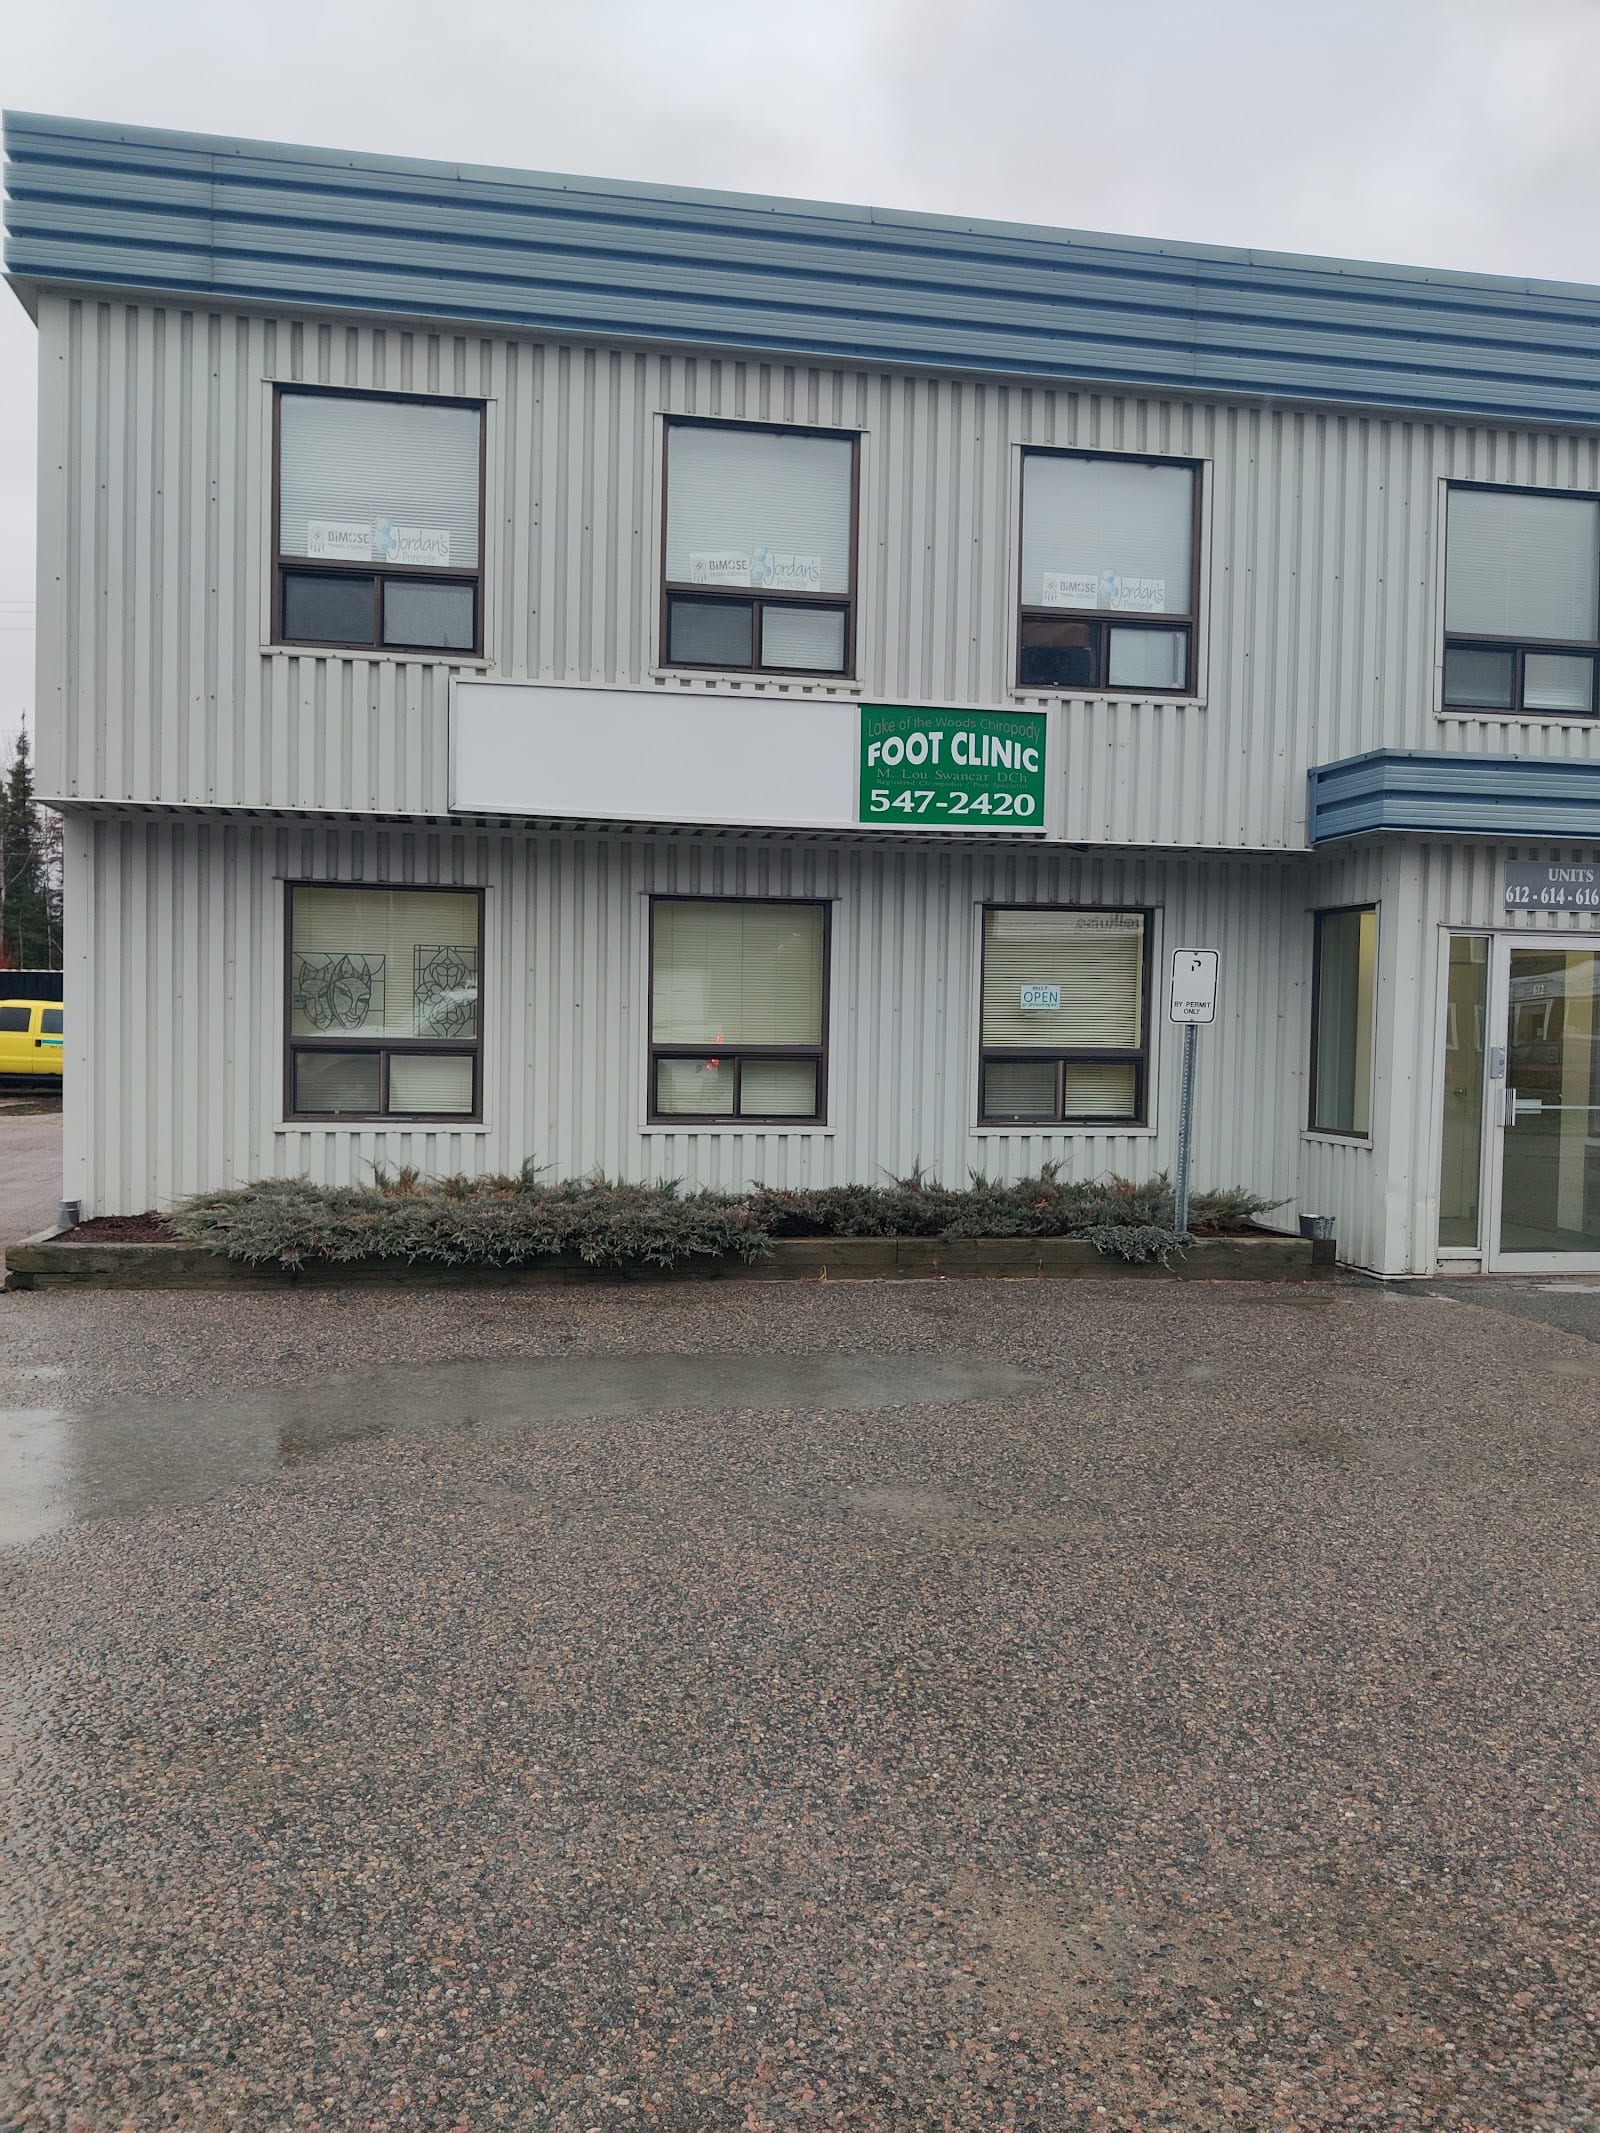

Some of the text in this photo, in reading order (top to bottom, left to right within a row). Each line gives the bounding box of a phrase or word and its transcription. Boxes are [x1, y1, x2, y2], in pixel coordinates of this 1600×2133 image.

[387, 528, 449, 561] Jordan's
[763, 554, 819, 586] Jordan's
[1110, 577, 1164, 608] Jordan's
[868, 717, 1040, 745] Lake of the Woods Chiropody
[868, 731, 1039, 773] FOOT CLINIC
[876, 768, 1028, 783] M. Lou Swancar DCh
[870, 789, 1036, 817] 547-2420
[1548, 868, 1594, 882] UNITS
[1024, 991, 1058, 1003] OPEN
[1174, 1000, 1183, 1008] BY
